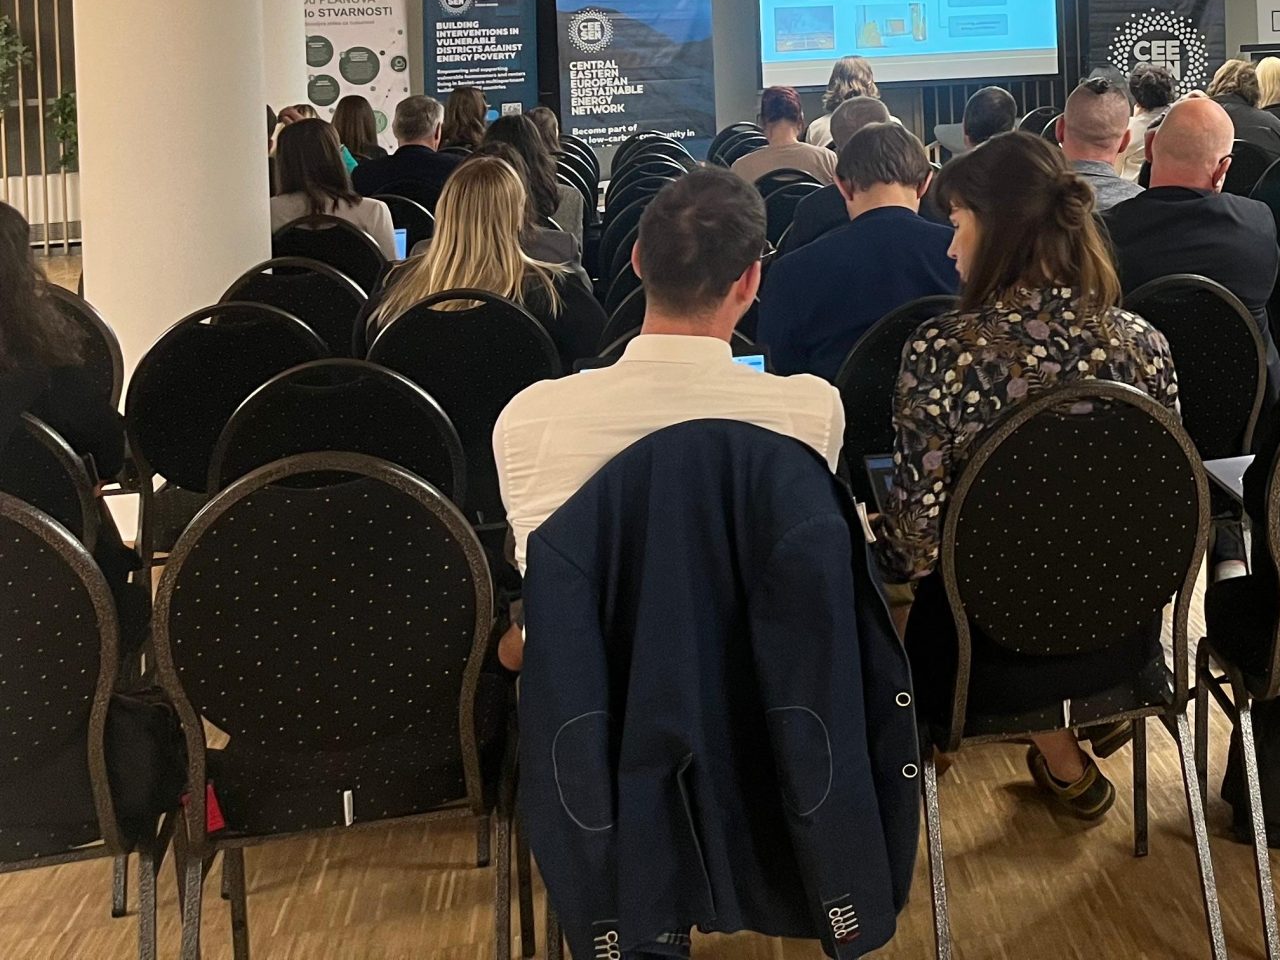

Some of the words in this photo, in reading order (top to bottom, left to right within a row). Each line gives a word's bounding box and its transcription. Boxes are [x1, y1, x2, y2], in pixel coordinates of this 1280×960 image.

[318, 6, 392, 18] STVARNOSTI
[436, 21, 480, 30] BUILDING
[580, 21, 601, 31] CEE
[436, 28, 508, 38] INTERVENTIONS
[509, 27, 519, 35] IN
[580, 30, 602, 40] SEN
[436, 37, 496, 46] VULNERABLE
[436, 45, 483, 54] DISTRICTS
[484, 44, 523, 52] AGAINST
[1133, 40, 1180, 61] CEE
[436, 54, 472, 63] ENERGY
[474, 52, 516, 61] POVERTY
[569, 60, 618, 71] CENTRAL
[570, 69, 619, 79] EASTERN
[570, 77, 628, 88] EUROPEAN
[571, 85, 644, 97] SUSTAINABLE
[571, 96, 613, 106] ENERGY
[571, 104, 625, 116] NETWORK
[572, 127, 607, 135] Become
[608, 125, 626, 135] part
[627, 124, 638, 132] of
[686, 129, 695, 137] in
